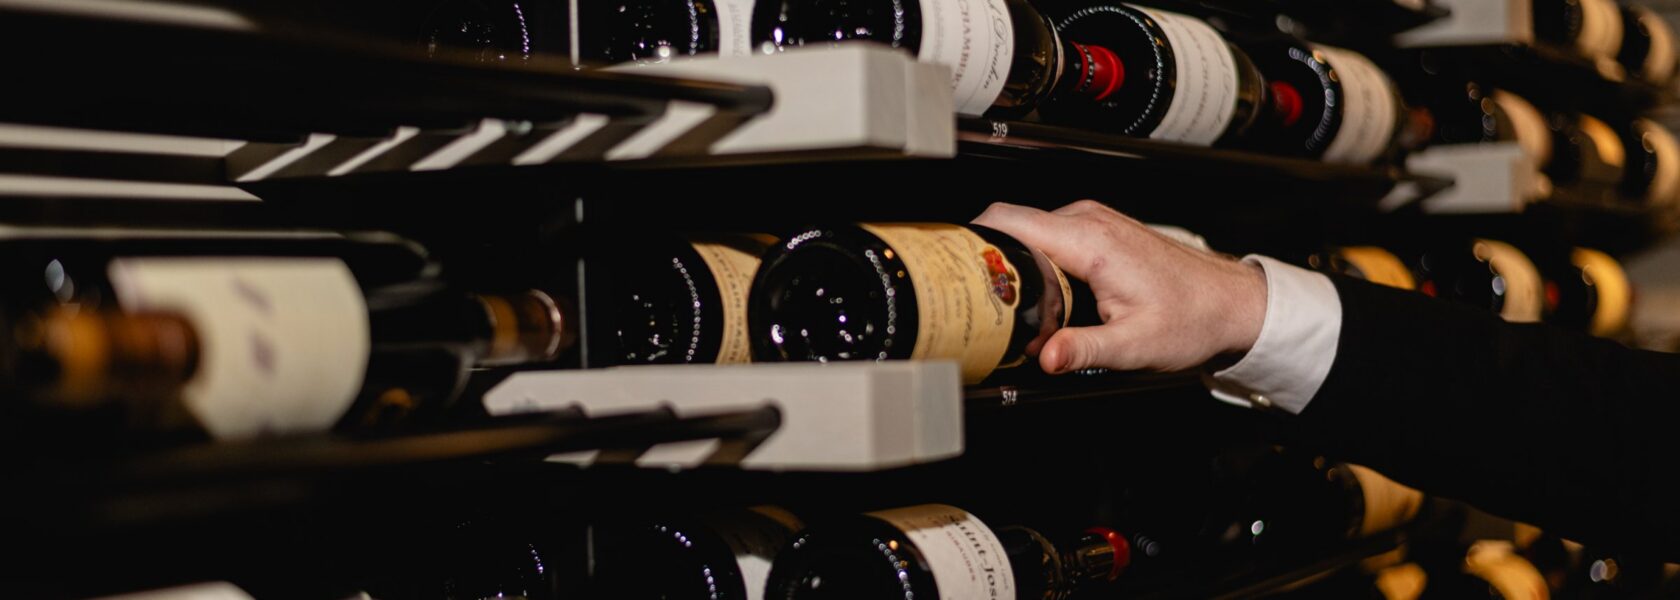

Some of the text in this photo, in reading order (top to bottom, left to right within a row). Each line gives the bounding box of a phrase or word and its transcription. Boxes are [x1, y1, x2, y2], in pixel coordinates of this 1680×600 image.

[951, 0, 971, 92] CHAMBERT
[992, 122, 1008, 137] 519
[1001, 390, 1018, 406] 514
